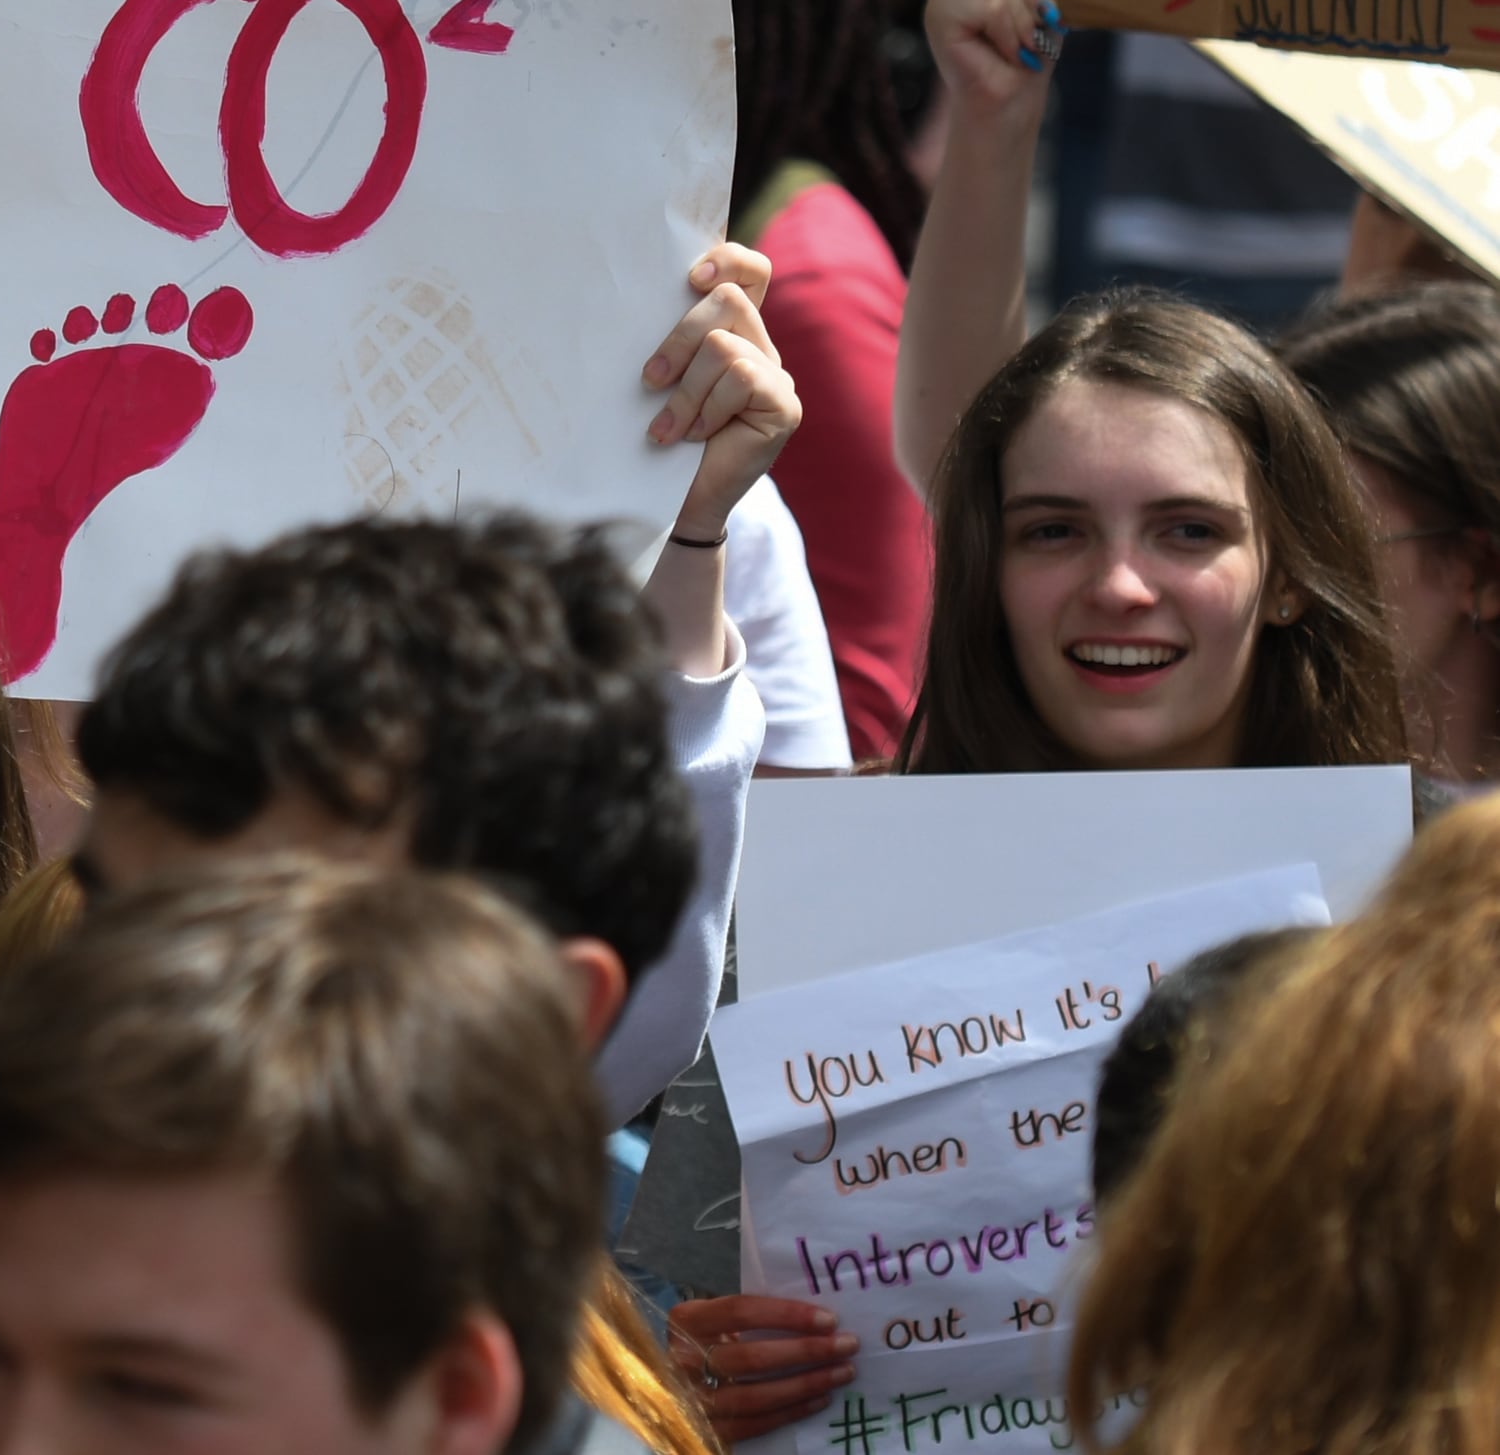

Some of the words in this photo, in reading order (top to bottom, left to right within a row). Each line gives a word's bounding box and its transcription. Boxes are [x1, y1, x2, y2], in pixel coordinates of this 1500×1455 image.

[835, 1136, 965, 1187] when
[1008, 1100, 1086, 1147] the
[797, 1205, 1095, 1294] Introverts
[885, 1307, 966, 1350] out
[1008, 1299, 1055, 1331] to
